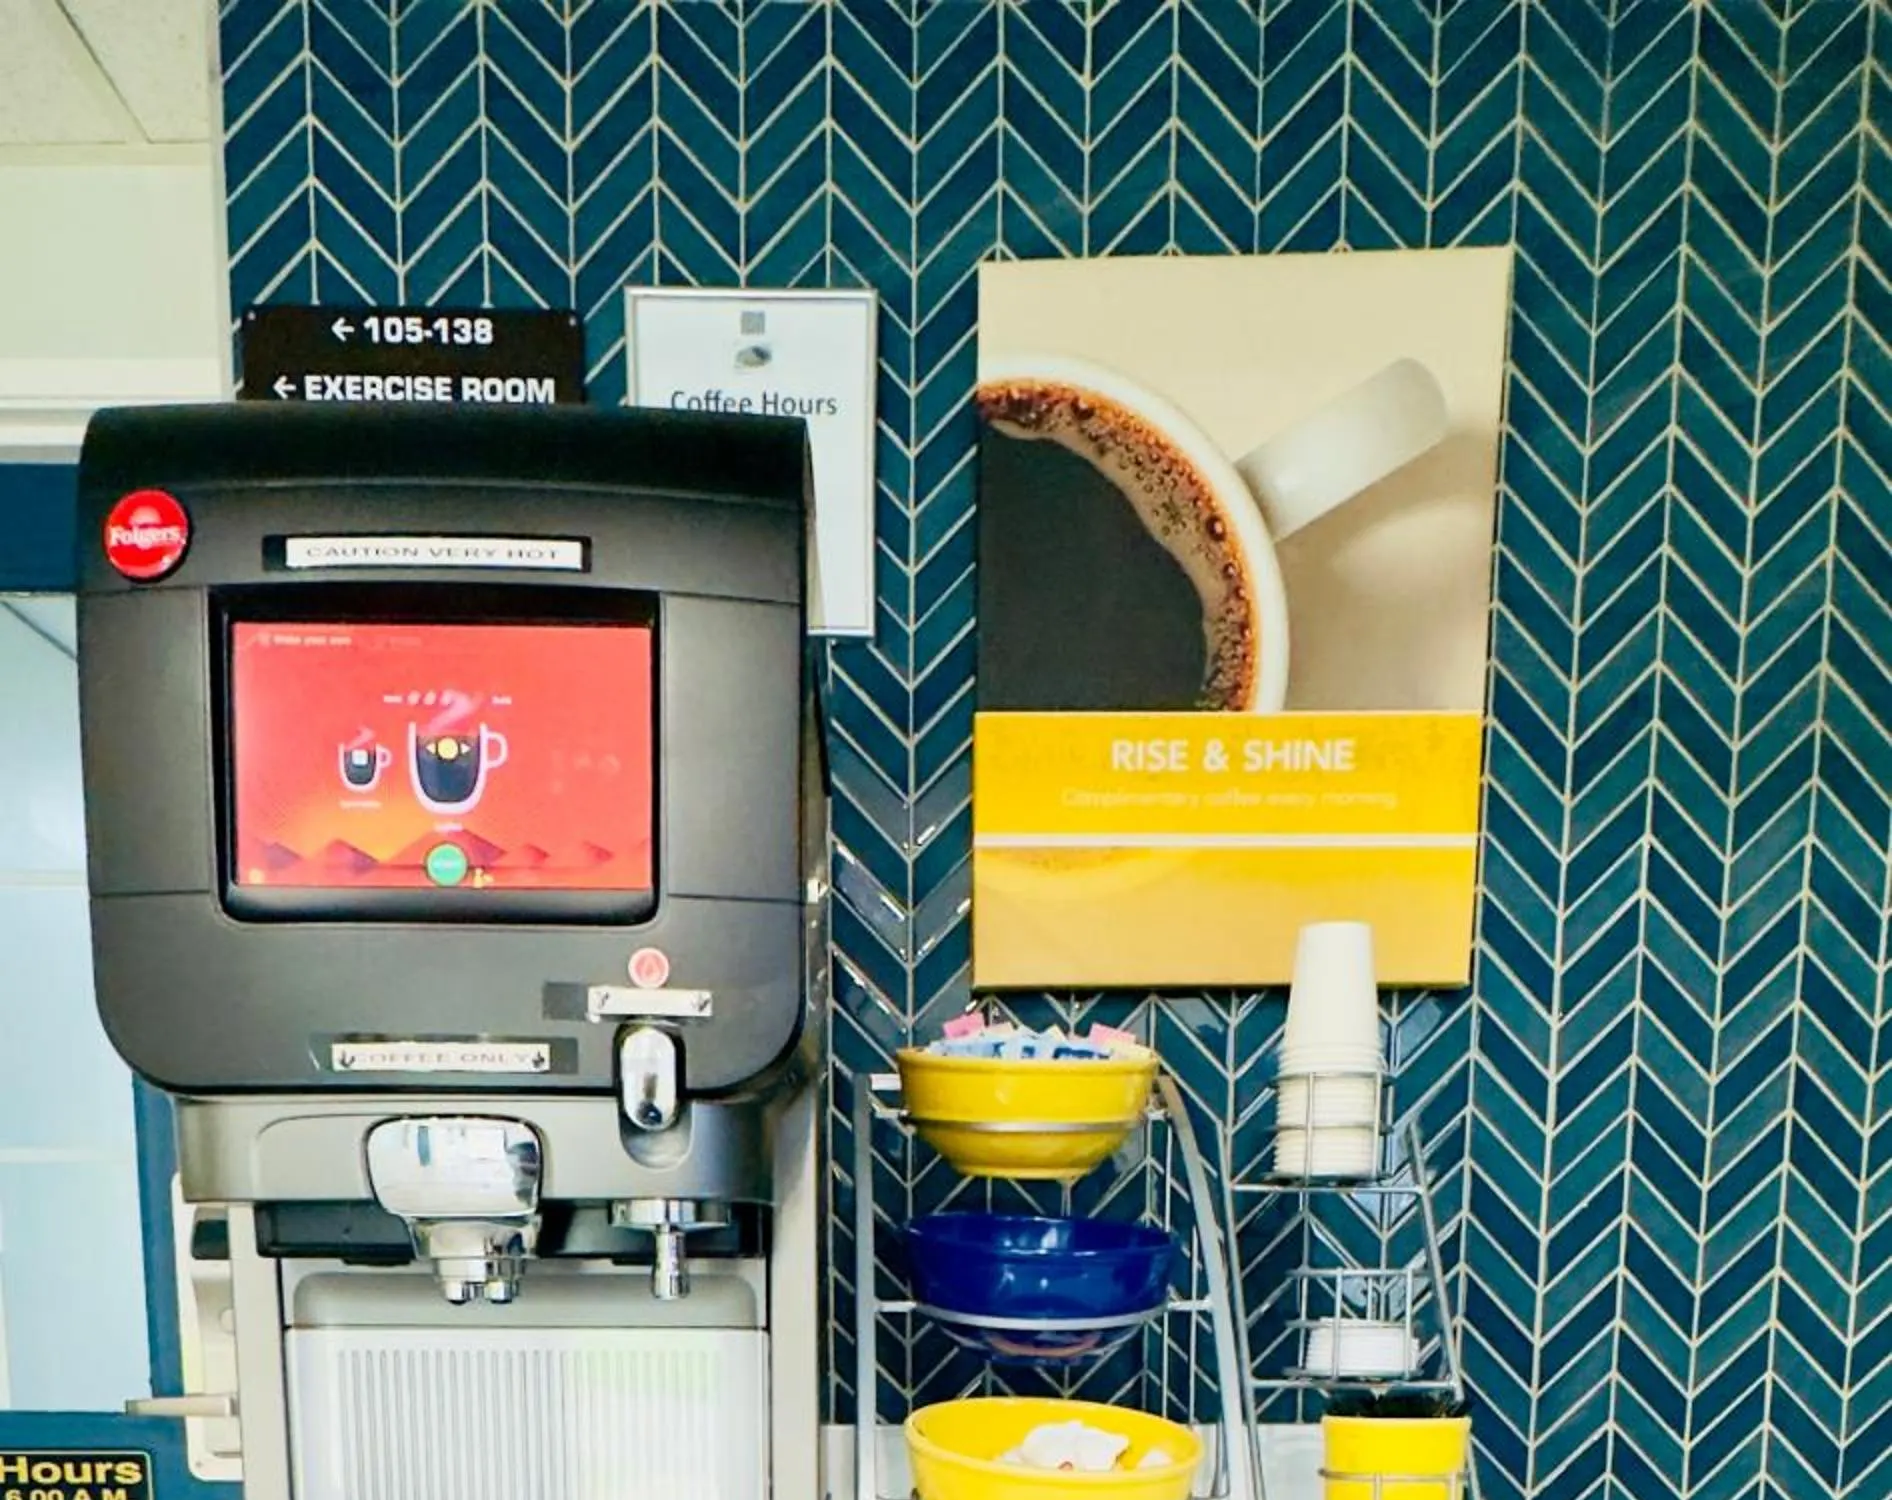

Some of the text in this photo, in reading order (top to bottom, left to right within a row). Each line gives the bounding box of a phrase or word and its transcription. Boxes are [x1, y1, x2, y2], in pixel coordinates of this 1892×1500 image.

[363, 316, 495, 345] 105-138
[303, 374, 556, 404] EXERCISE ROOM
[671, 389, 838, 416] Coffee Hours
[306, 545, 560, 560] CAUTION VERY HOT
[1110, 738, 1357, 773] RISE & SHINE
[354, 1049, 532, 1065] COFFEE ONLY
[0, 1455, 143, 1485] Hours
